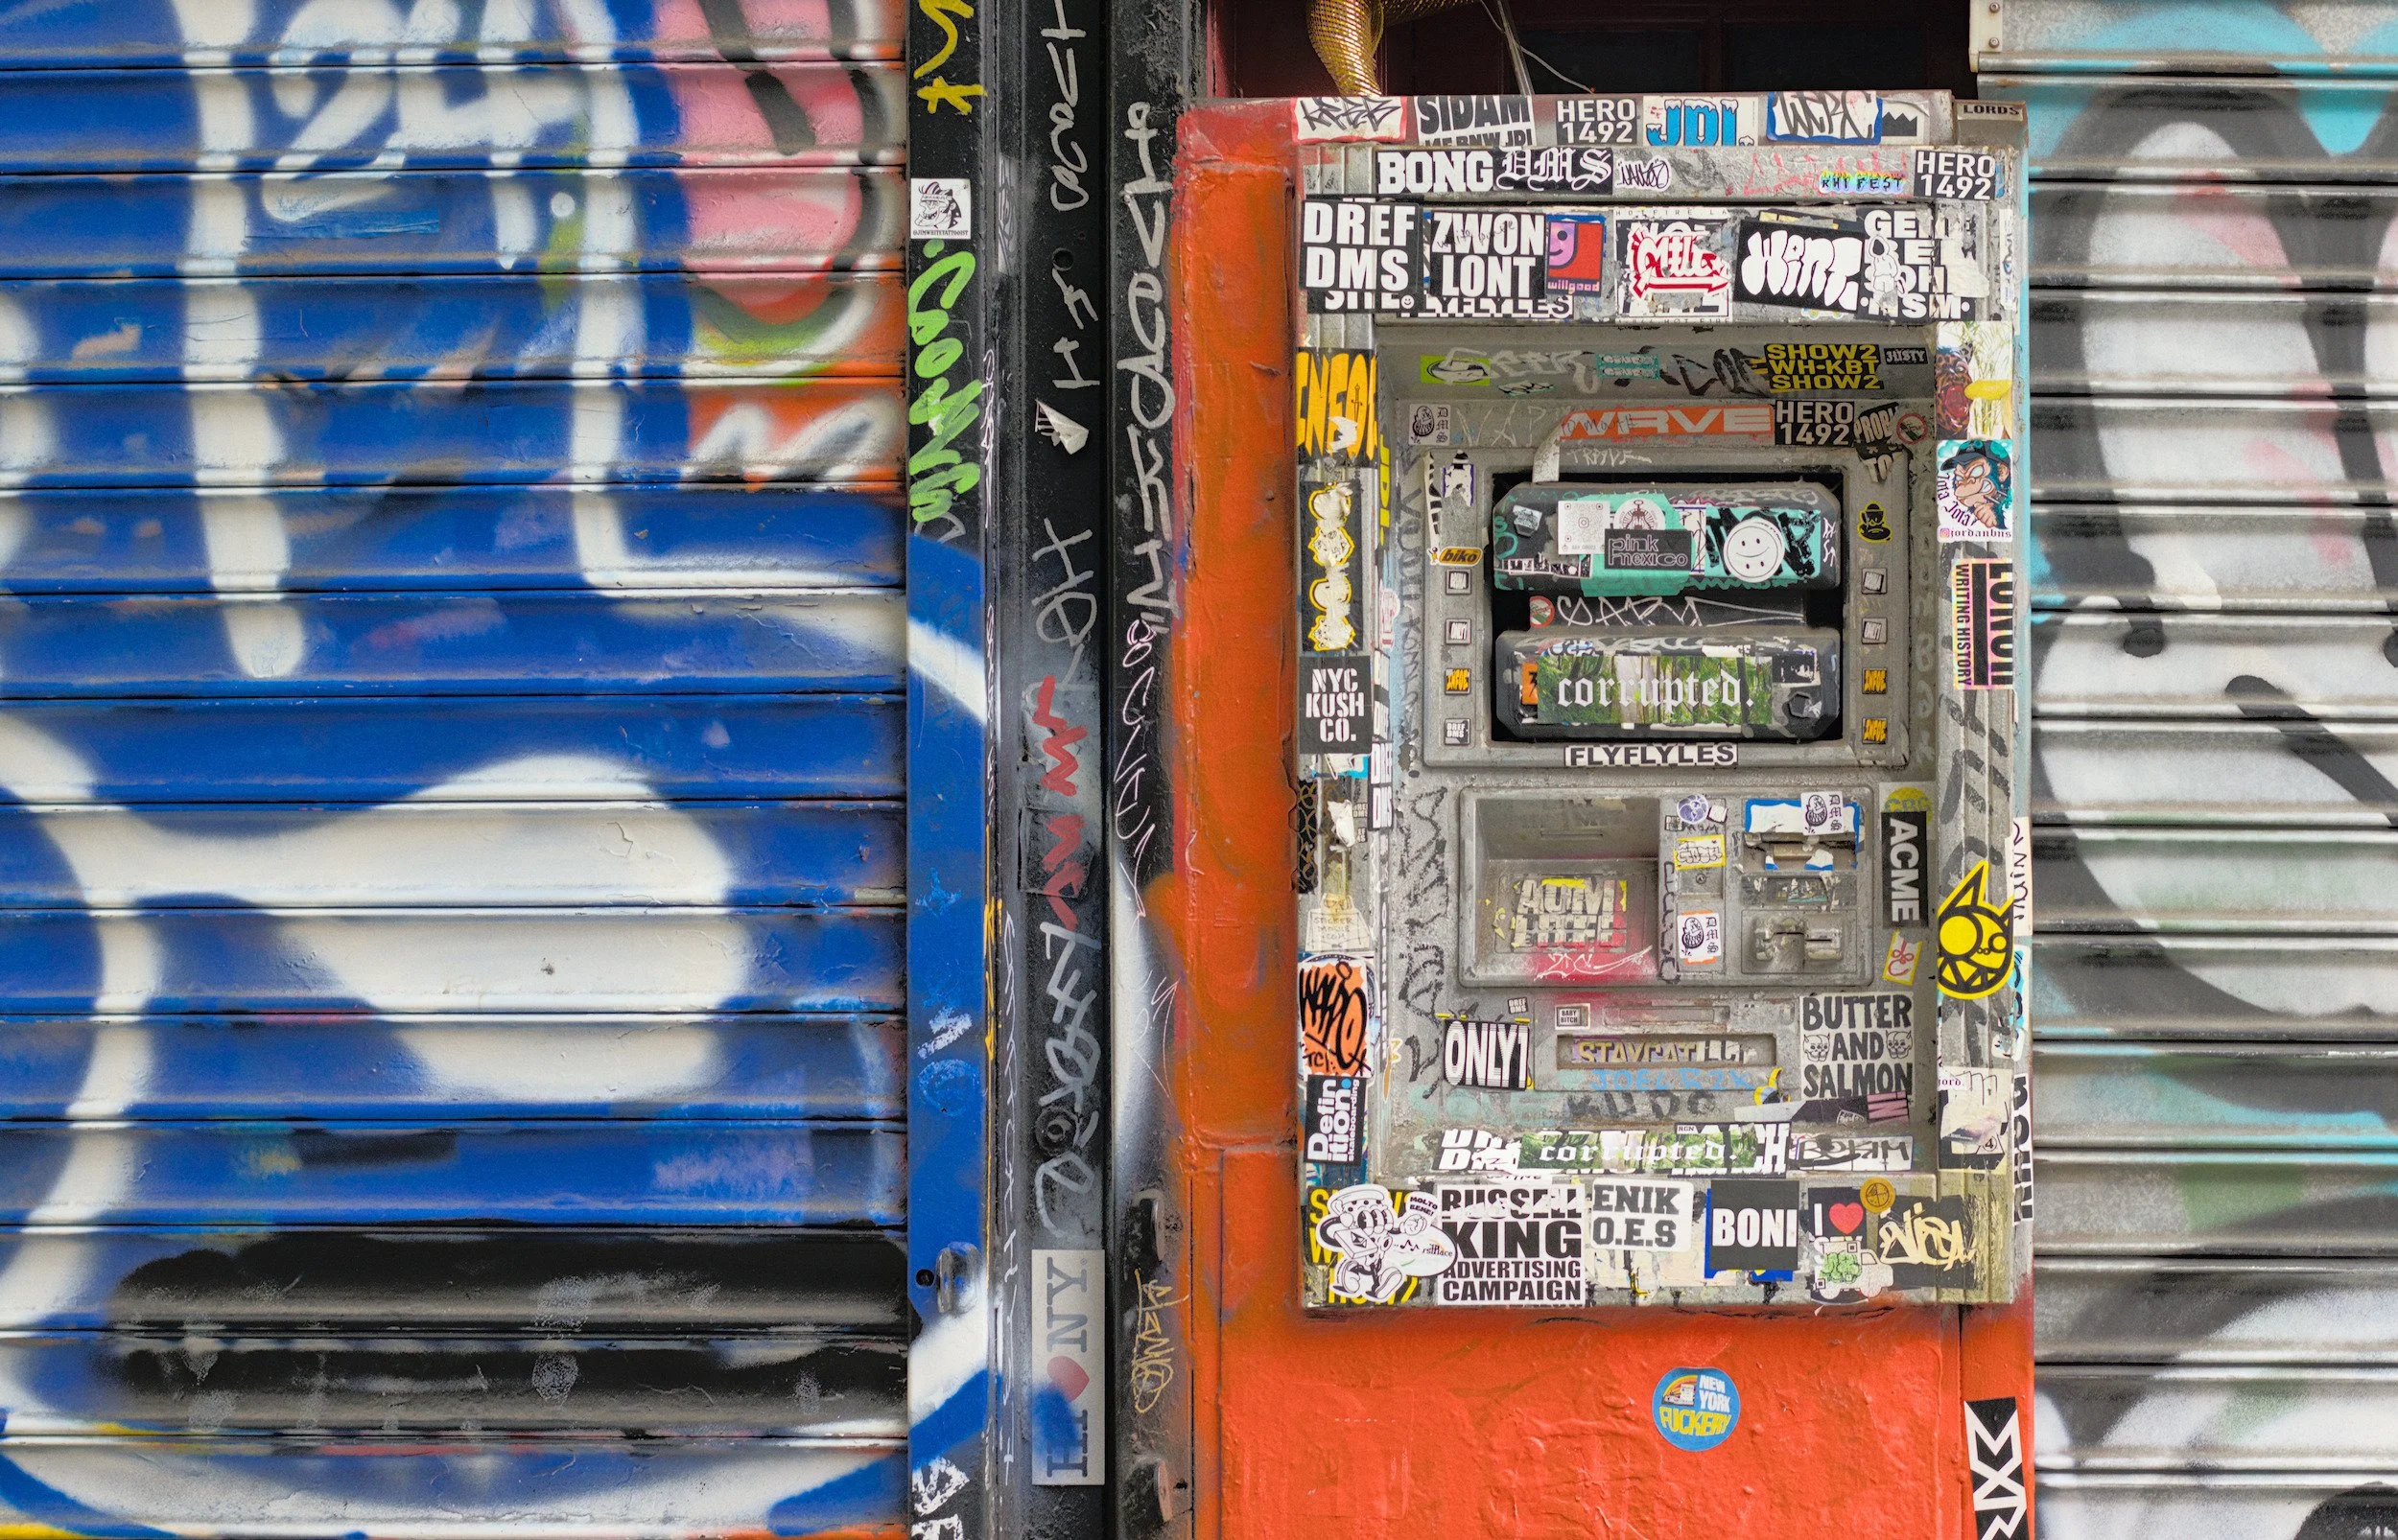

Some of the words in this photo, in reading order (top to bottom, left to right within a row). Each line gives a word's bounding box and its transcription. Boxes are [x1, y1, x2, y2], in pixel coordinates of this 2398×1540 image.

[1417, 95, 1531, 135] SIDAM
[1557, 98, 1636, 123] HERO
[1963, 105, 2021, 116] LORDS
[1562, 121, 1633, 144] 1492
[1377, 150, 1493, 194] BONG
[1495, 146, 1611, 192] DMS
[1916, 151, 1996, 178] HERO
[1919, 174, 1992, 201] 1492
[1303, 201, 1415, 246] DREF
[1430, 212, 1545, 255] ZWON
[1305, 246, 1409, 291] DMS
[1441, 255, 1536, 299] LONT
[1547, 279, 1600, 293] willgood
[1766, 344, 1877, 361] SHOW2
[1771, 374, 1882, 390] SHOW2
[1775, 401, 1853, 425] HERO
[1779, 422, 1849, 446] 1492
[1609, 534, 1659, 553] pink
[1609, 550, 1688, 567] mexico
[1956, 564, 1971, 627] WRITING
[1957, 629, 1972, 686] HISTORY
[1312, 667, 1358, 693] NYC
[1558, 667, 1754, 716] corrupted.
[1305, 691, 1365, 718] KUSH
[1320, 717, 1357, 743] CO.
[1569, 744, 1735, 766] FLYFLYLES
[1890, 817, 1920, 922] ACME
[1802, 993, 1913, 1031] BUTTER
[1831, 1031, 1884, 1062] AND
[1803, 1062, 1913, 1100] SALMON
[1348, 1078, 1360, 1162] skateboarding
[1539, 1137, 1739, 1165] corrupted.
[1409, 1196, 1438, 1210] MOLTO
[1592, 1184, 1681, 1215] ENIK
[1711, 1207, 1798, 1248] BONI
[1813, 1202, 1822, 1237] I
[1441, 1220, 1582, 1259] KING
[1592, 1219, 1677, 1248] O.E.S
[1442, 1260, 1581, 1279] ADVERTISING
[1443, 1280, 1581, 1301] CAMPAIGN
[1699, 1374, 1726, 1394] NEW
[1699, 1388, 1730, 1413] YORK
